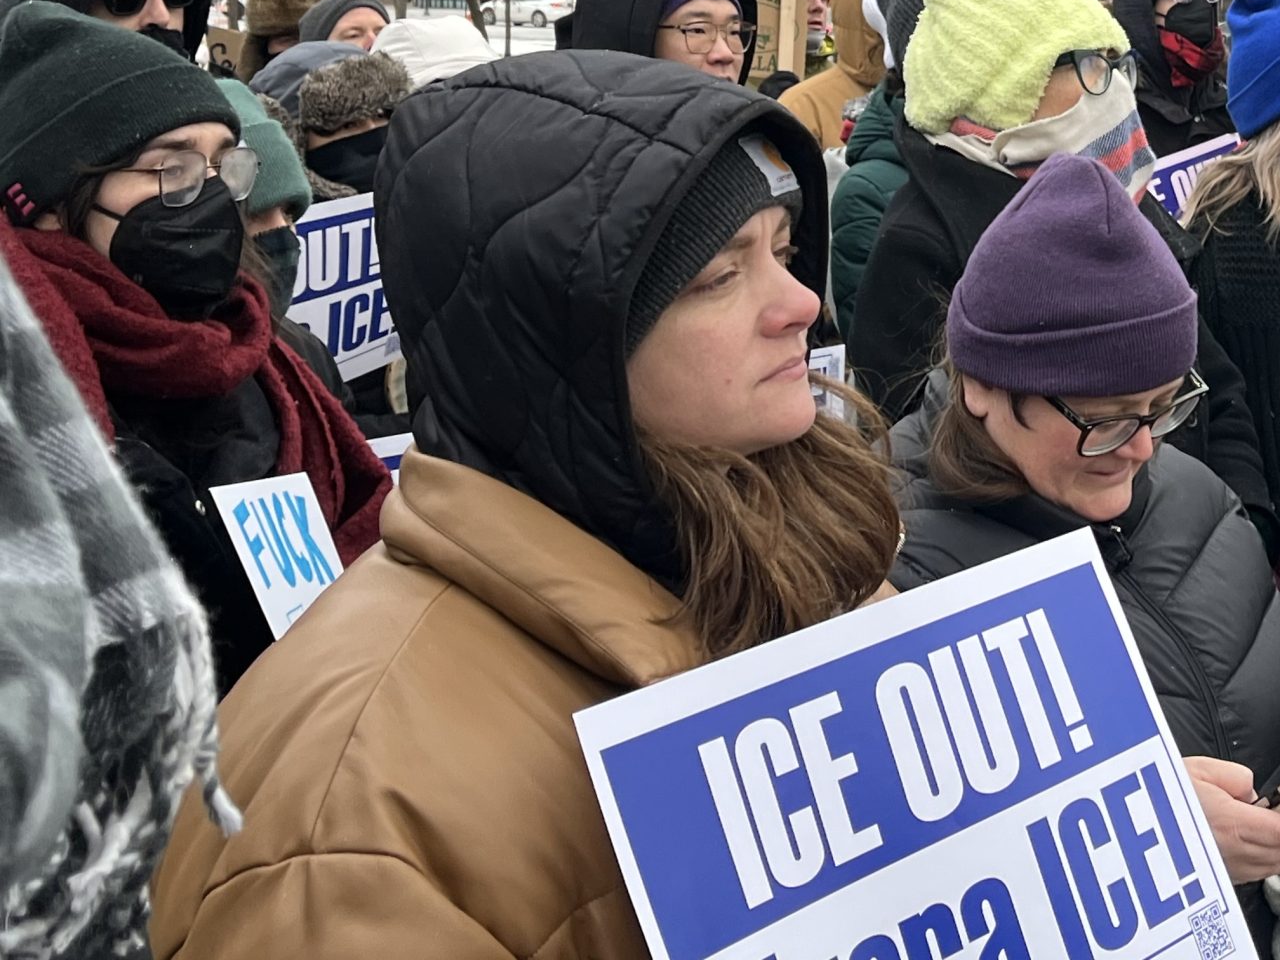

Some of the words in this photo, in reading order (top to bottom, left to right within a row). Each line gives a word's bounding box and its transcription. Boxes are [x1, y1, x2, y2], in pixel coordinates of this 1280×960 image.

[232, 490, 335, 590] FUCK
[697, 691, 883, 910] ICE
[875, 608, 1094, 822] OUT!
[1025, 761, 1206, 960] ICE!
